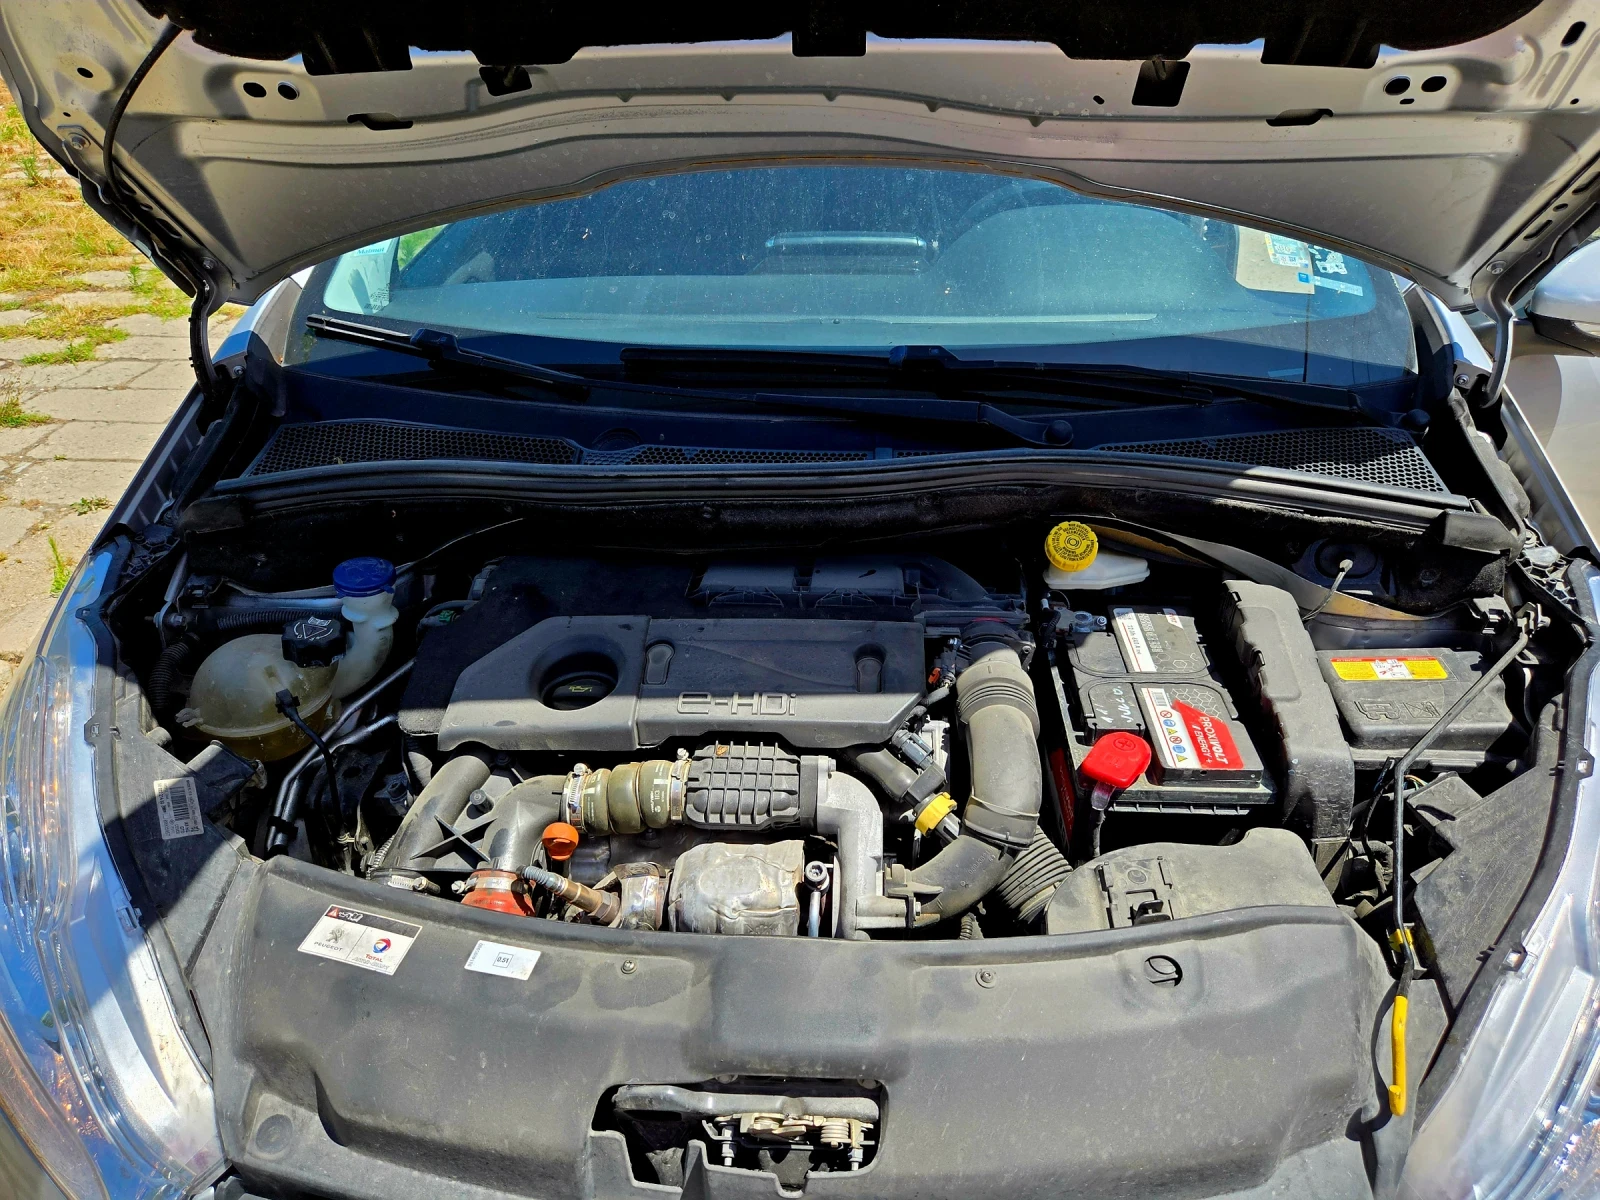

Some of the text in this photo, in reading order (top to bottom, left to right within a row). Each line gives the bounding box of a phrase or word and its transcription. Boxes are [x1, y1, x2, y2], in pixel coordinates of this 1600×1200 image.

[1200, 716, 1228, 764] PROXIVOLT
[313, 941, 343, 952] PEUGEOT
[365, 953, 383, 963] TOTAL
[496, 956, 510, 964] 0.51
